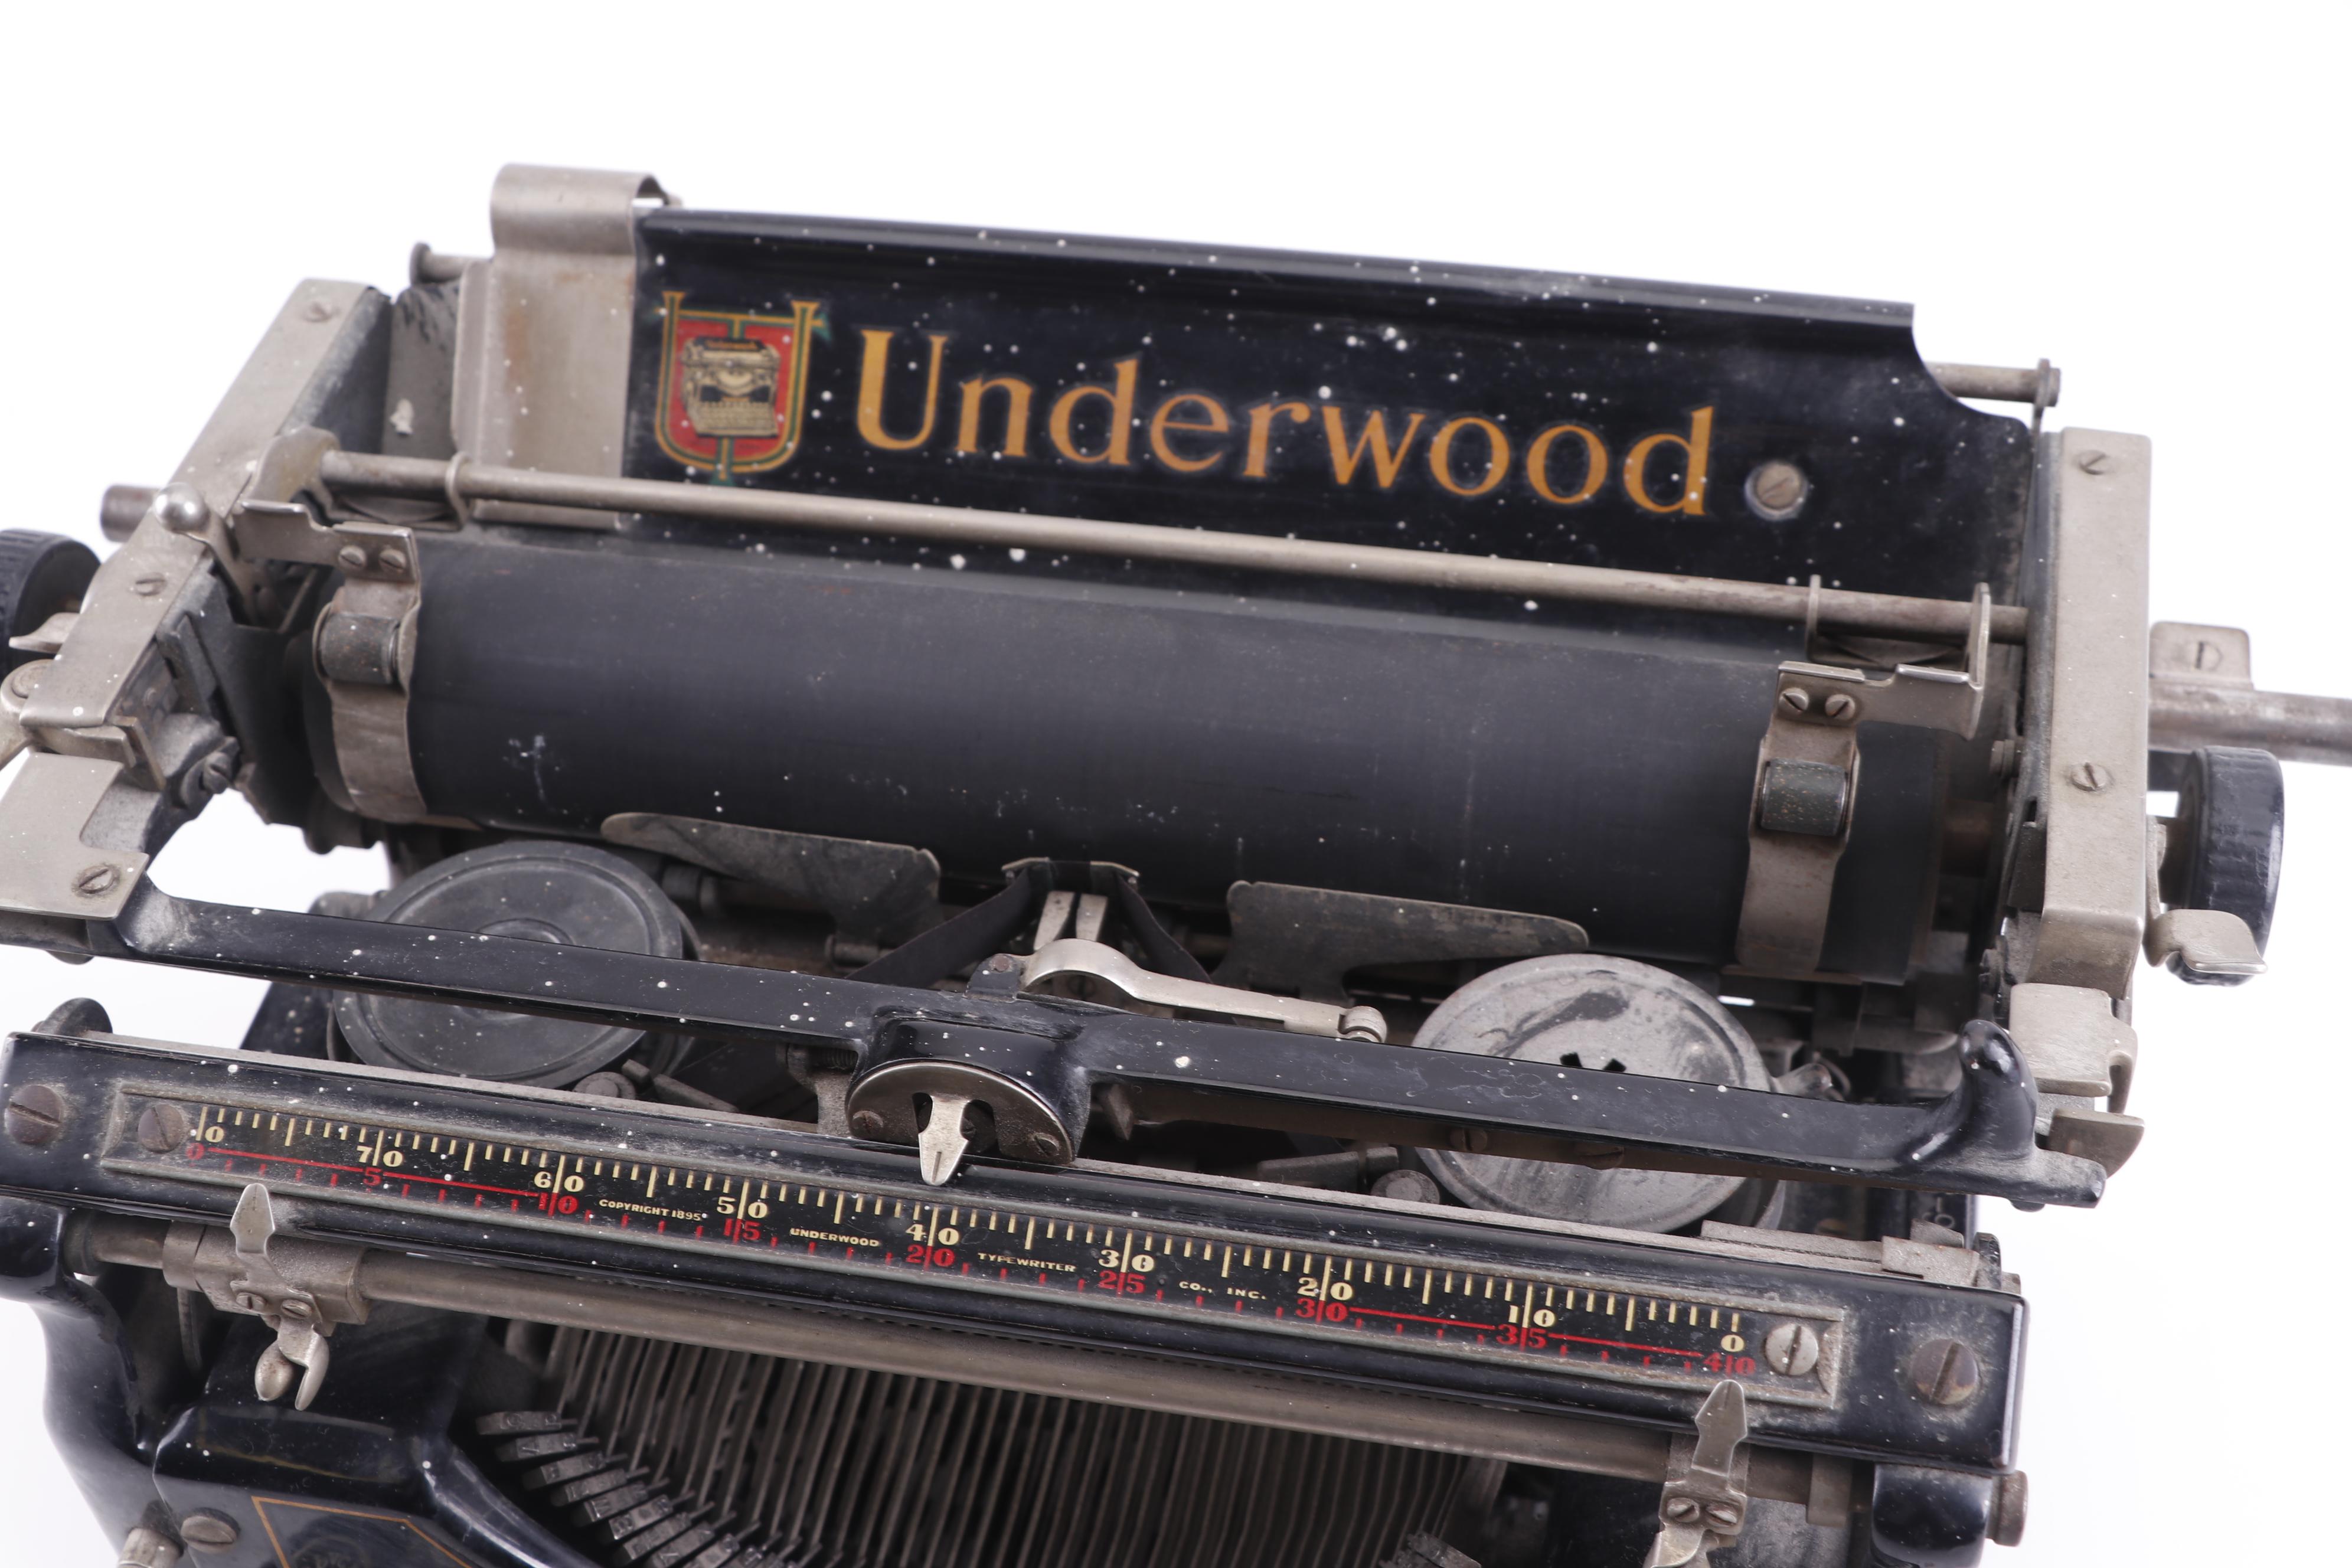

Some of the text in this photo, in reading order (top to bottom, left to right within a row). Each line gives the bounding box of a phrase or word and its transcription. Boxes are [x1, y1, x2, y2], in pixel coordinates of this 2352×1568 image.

[855, 329, 1714, 517] Underwood
[186, 1142, 1756, 1376] 0 5 10 15 20 25 30 35 40
[356, 1145, 403, 1168] 70
[534, 1171, 584, 1193] 60
[716, 1196, 768, 1220] 50
[905, 1223, 960, 1246] 40
[1098, 1249, 1155, 1273] 30
[1297, 1277, 1354, 1301] 20
[1509, 1305, 1556, 1328] 10
[1720, 1334, 1745, 1353] 0
[598, 1198, 669, 1217] COPYRIGHT
[671, 1210, 702, 1221] 1895
[789, 1227, 880, 1247] UNDERWOOD
[978, 1252, 1077, 1273] TYPEWRITER
[1227, 1287, 1268, 1300] INC.
